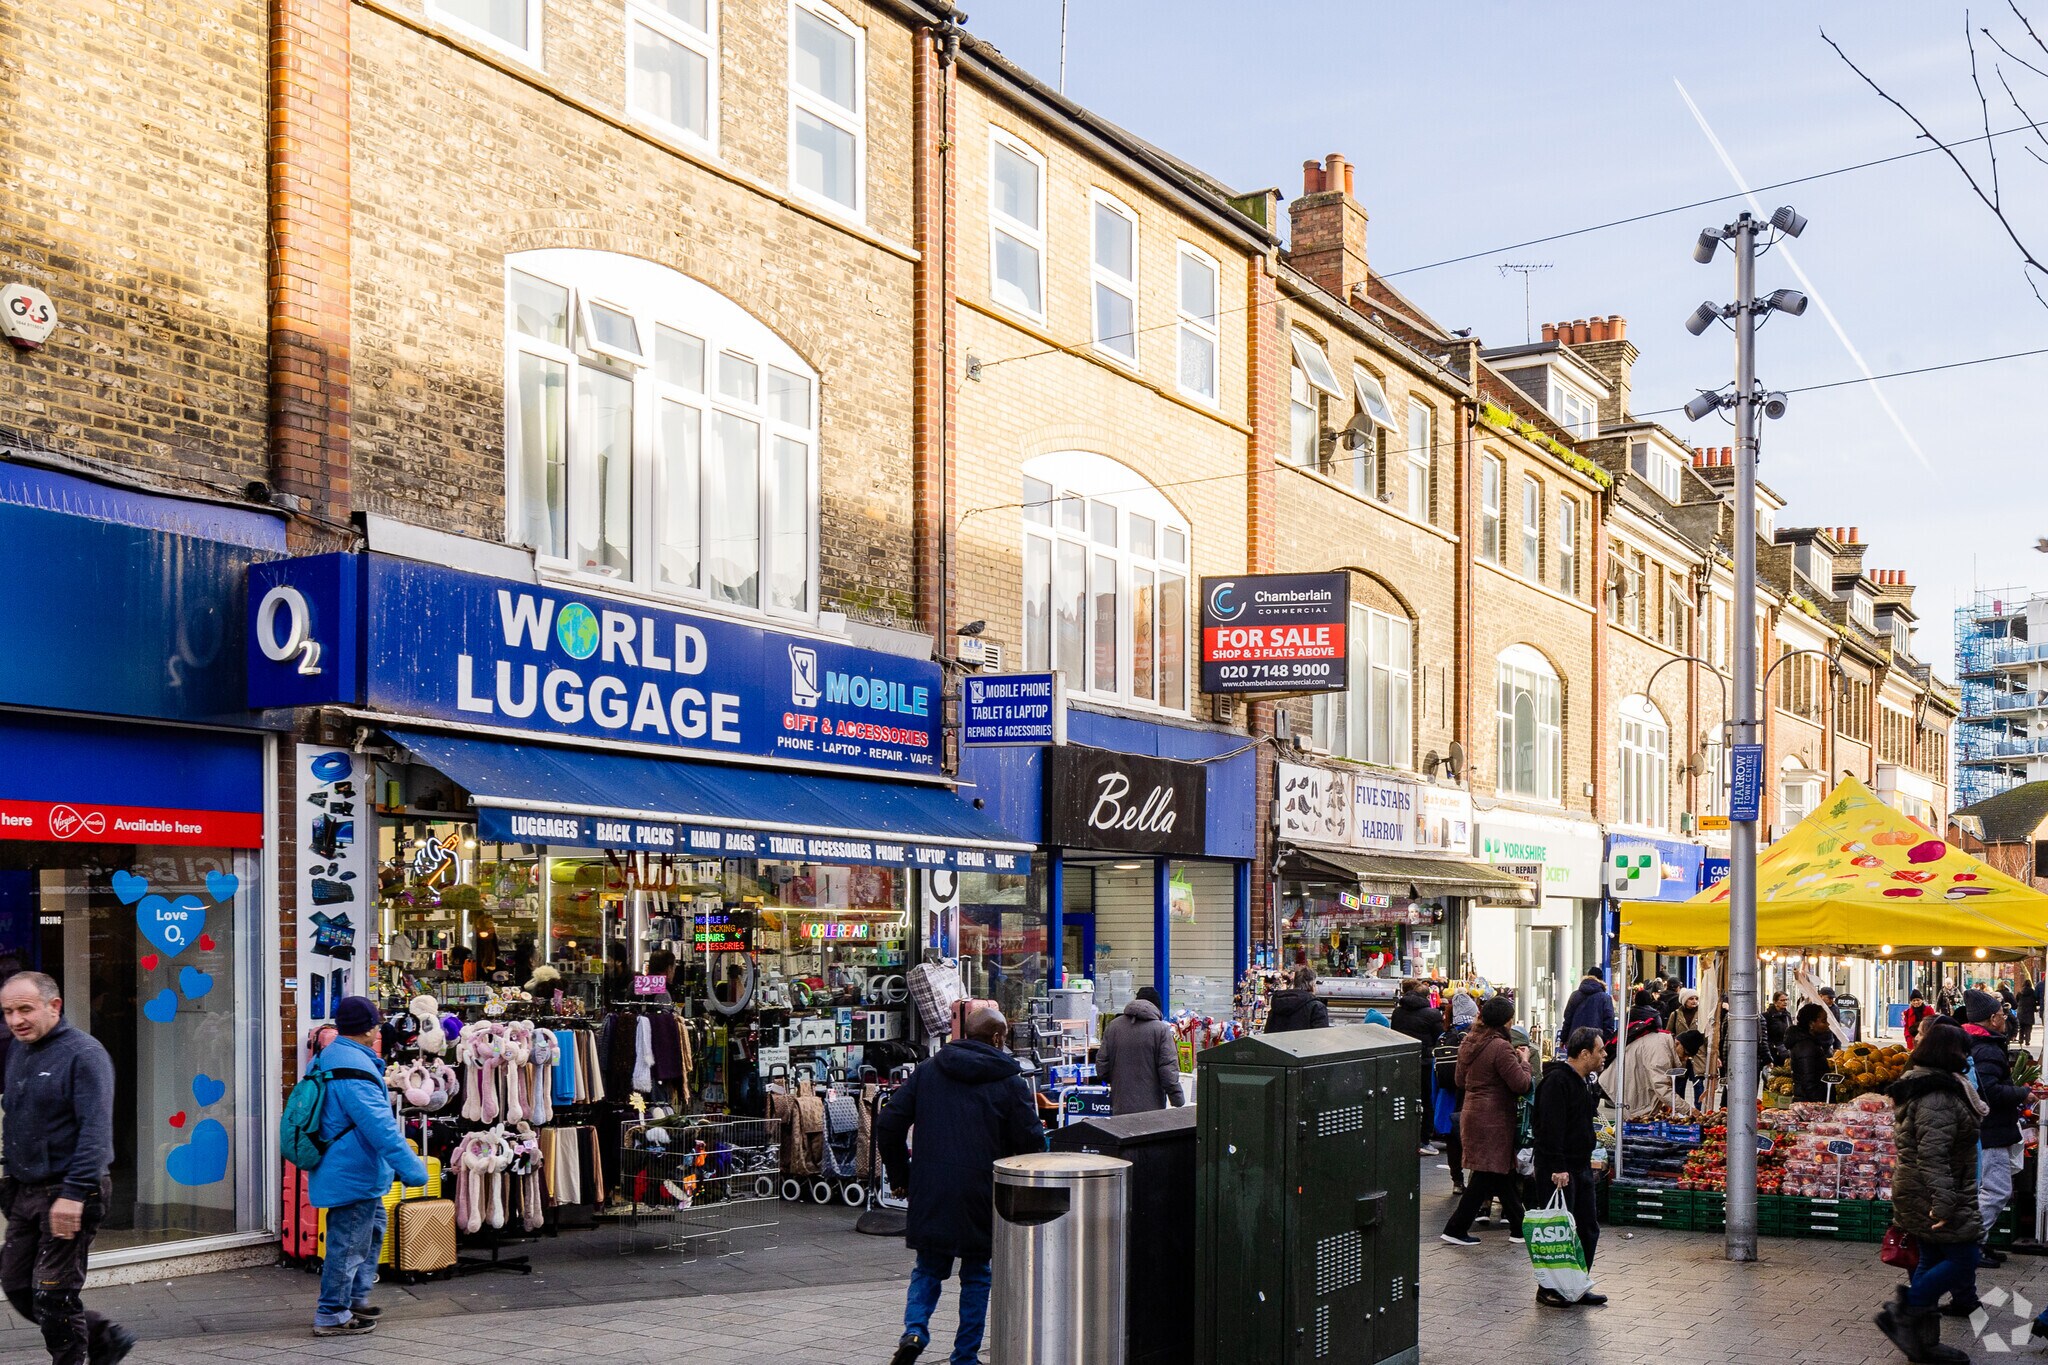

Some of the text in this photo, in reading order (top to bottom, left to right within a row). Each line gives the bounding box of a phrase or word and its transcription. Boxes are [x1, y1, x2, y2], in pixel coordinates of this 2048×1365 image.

[10, 296, 48, 324] G4S
[1255, 590, 1331, 602] Chamberlain
[256, 586, 321, 674] O2
[1218, 628, 1329, 648] FOR SALE
[1213, 647, 1334, 659] SHOP & 3 FLATS ABOVE
[1220, 664, 1330, 678] 020 7148 9000
[986, 683, 1050, 698] MOBILE PHONE
[1222, 679, 1325, 687] www.chamberlaincommercial.com
[458, 654, 740, 743] LUGGAGE
[826, 671, 928, 717] MOBILE
[972, 705, 1048, 720] TABLET & LAPTOP
[783, 712, 929, 748] GIFT & ACCESSORIES
[968, 725, 1051, 737] REPAIRS & ACCESSORIES
[778, 736, 813, 750] PHONE
[823, 742, 860, 756] LAPTOP
[870, 748, 902, 761] REPAIR
[910, 753, 933, 765] VAPE
[1734, 755, 1746, 805] HARROW
[1088, 772, 1176, 833] Bella
[1356, 785, 1378, 806] FIVE
[1381, 789, 1410, 810] STARS
[1, 813, 32, 826] here
[53, 811, 77, 832] Virgin
[114, 818, 202, 833] Available here
[1362, 820, 1404, 842] HARROW
[512, 816, 578, 838] LUGGAGES
[597, 823, 630, 842] BACK
[636, 826, 674, 846] PACKS
[691, 830, 720, 849] HAND
[726, 833, 755, 851] BAGS
[769, 836, 806, 856] TRAVEL
[808, 839, 871, 859] ACCESSORIES
[876, 844, 904, 862] PHONE
[916, 848, 945, 864] LAPTOP
[957, 851, 985, 867] REPAIR
[995, 854, 1015, 868] VAPE
[1504, 842, 1546, 861] YORKSHIRE
[1516, 866, 1537, 874] REPAIR
[1546, 866, 1570, 882] OCIETY
[1711, 876, 1724, 884] LO
[40, 916, 62, 925] MSUNG
[156, 909, 188, 921] Love
[164, 925, 185, 945] O2
[696, 925, 735, 933] UNOCKING
[695, 942, 744, 951] ACESSORIES
[635, 976, 665, 991] £2.99
[1092, 1103, 1110, 1111] Lyca
[1531, 1226, 1572, 1243] ASDA
